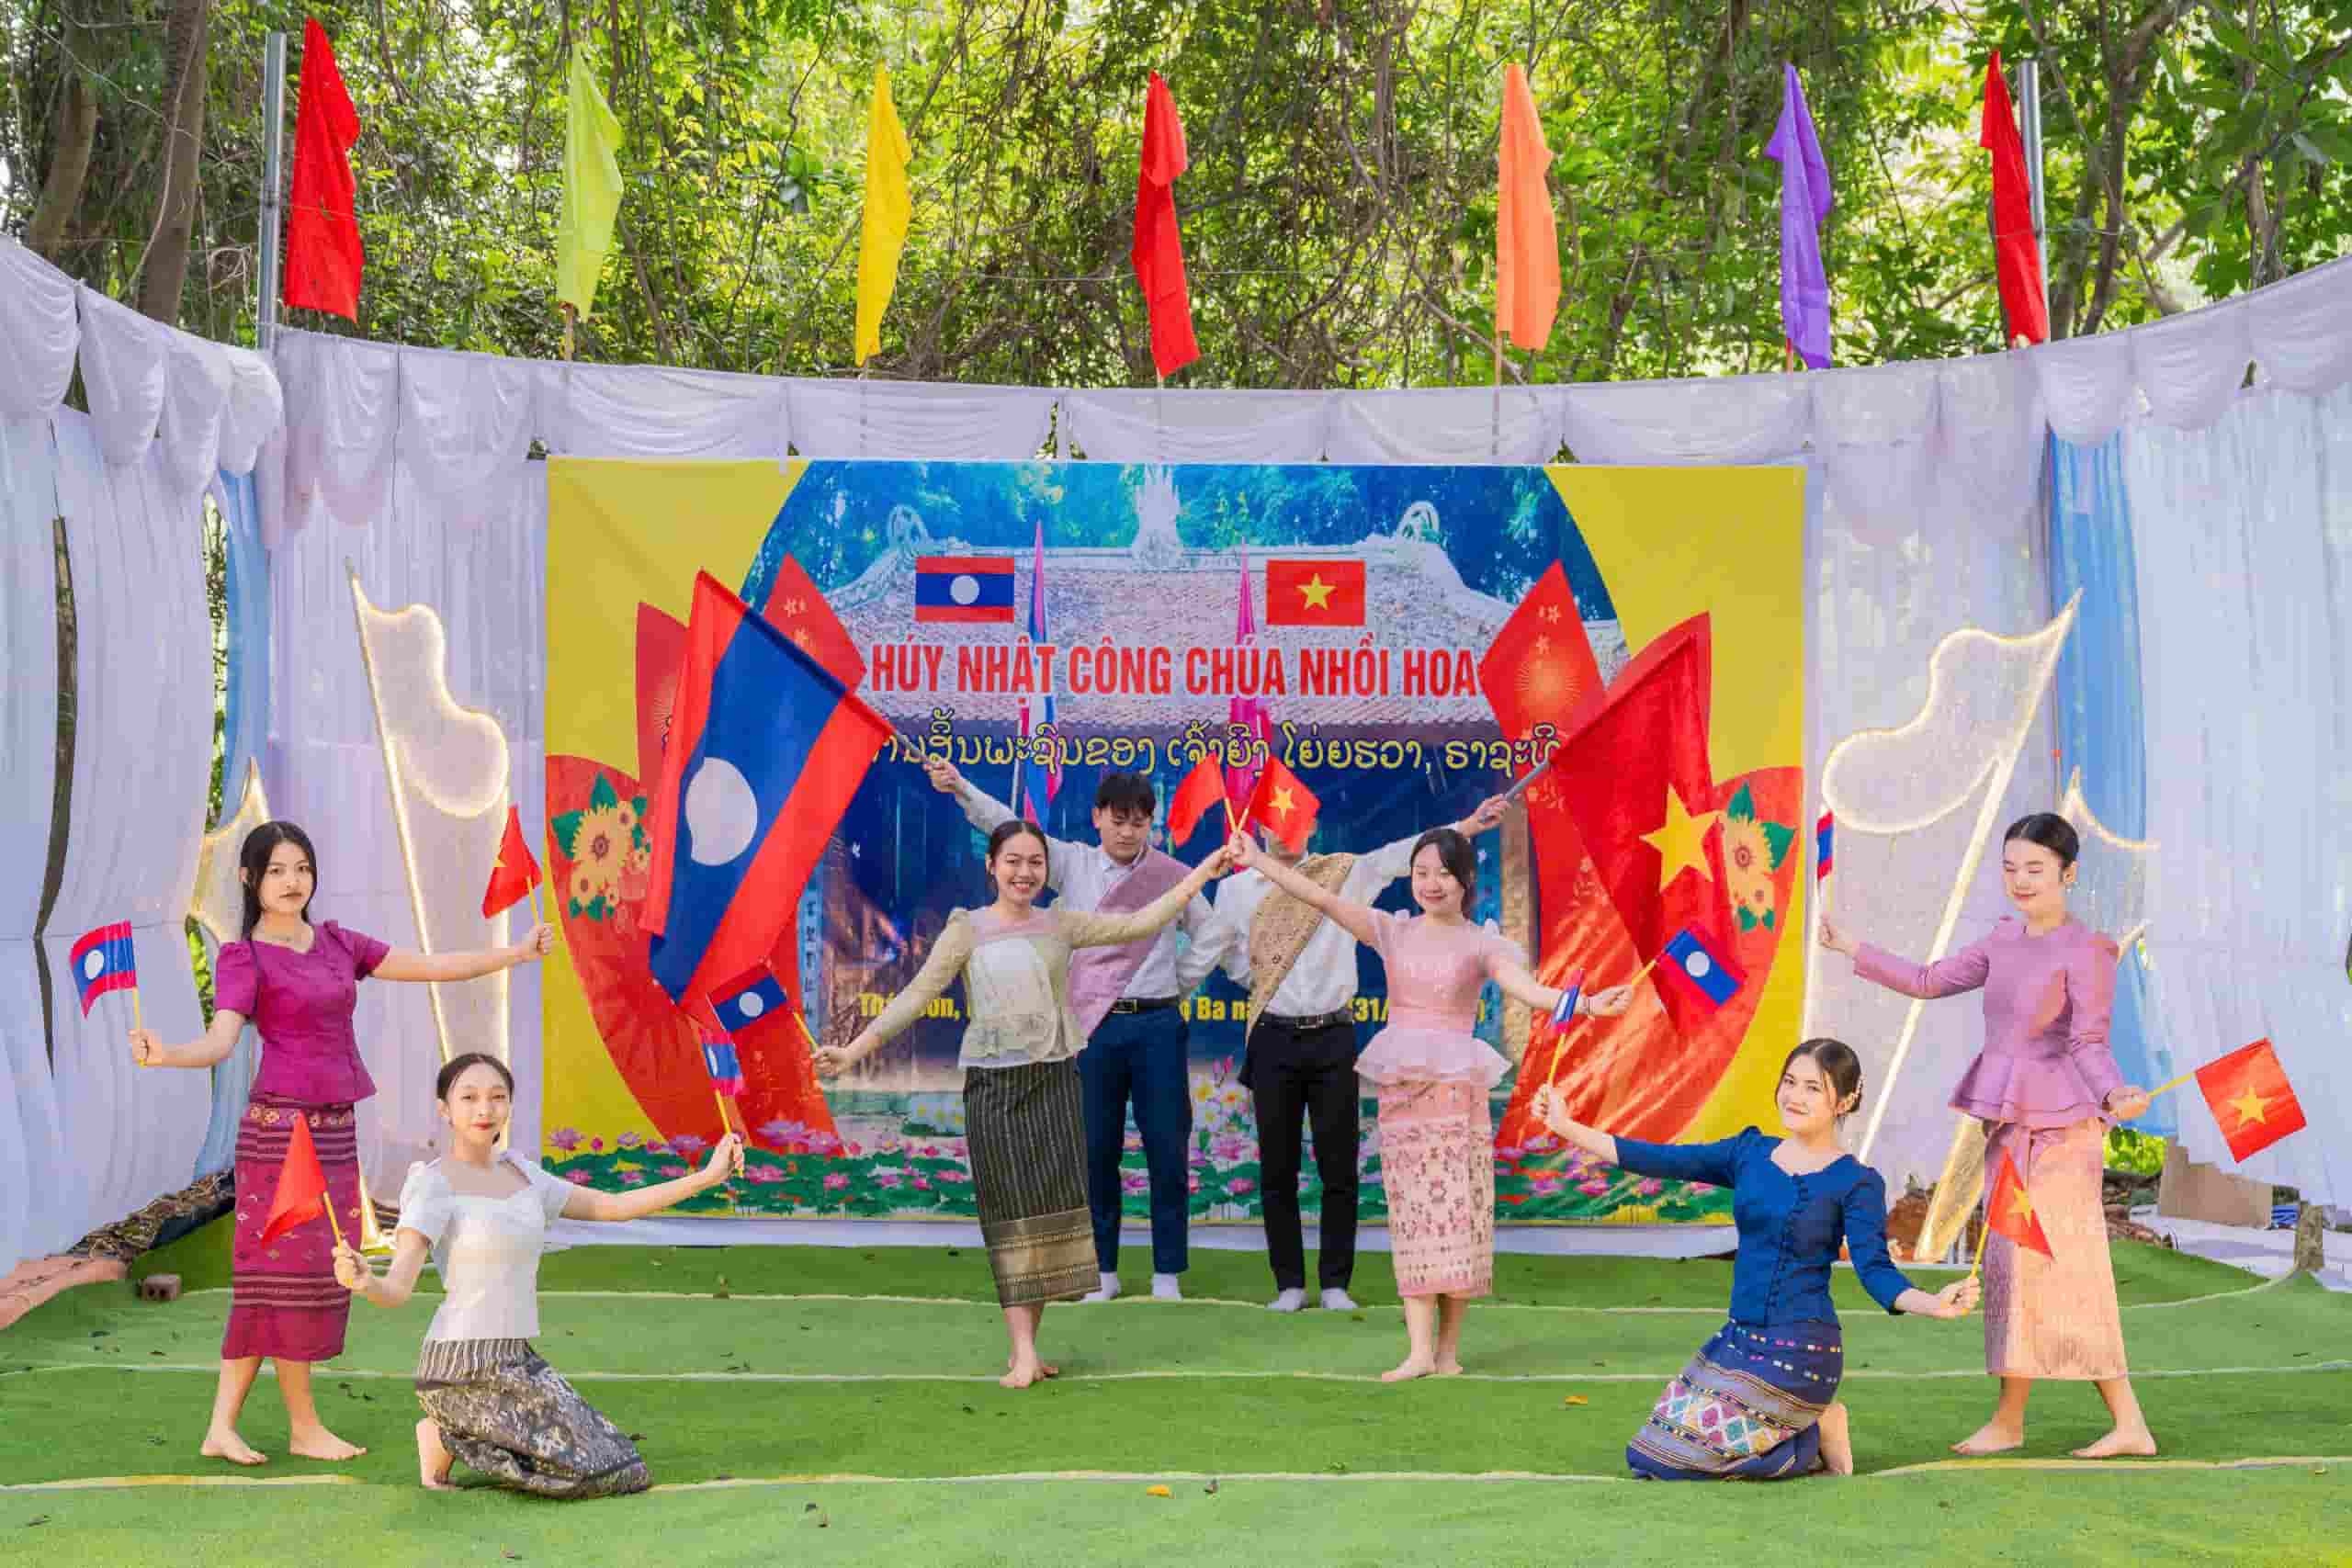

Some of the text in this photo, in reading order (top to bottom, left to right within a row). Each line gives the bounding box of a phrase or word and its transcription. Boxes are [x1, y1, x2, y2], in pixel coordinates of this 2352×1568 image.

[873, 631, 1476, 704] HÚY NHẬT CÔNG CHÚA NHỒI HOA
[1197, 996, 1227, 1021] Ba
